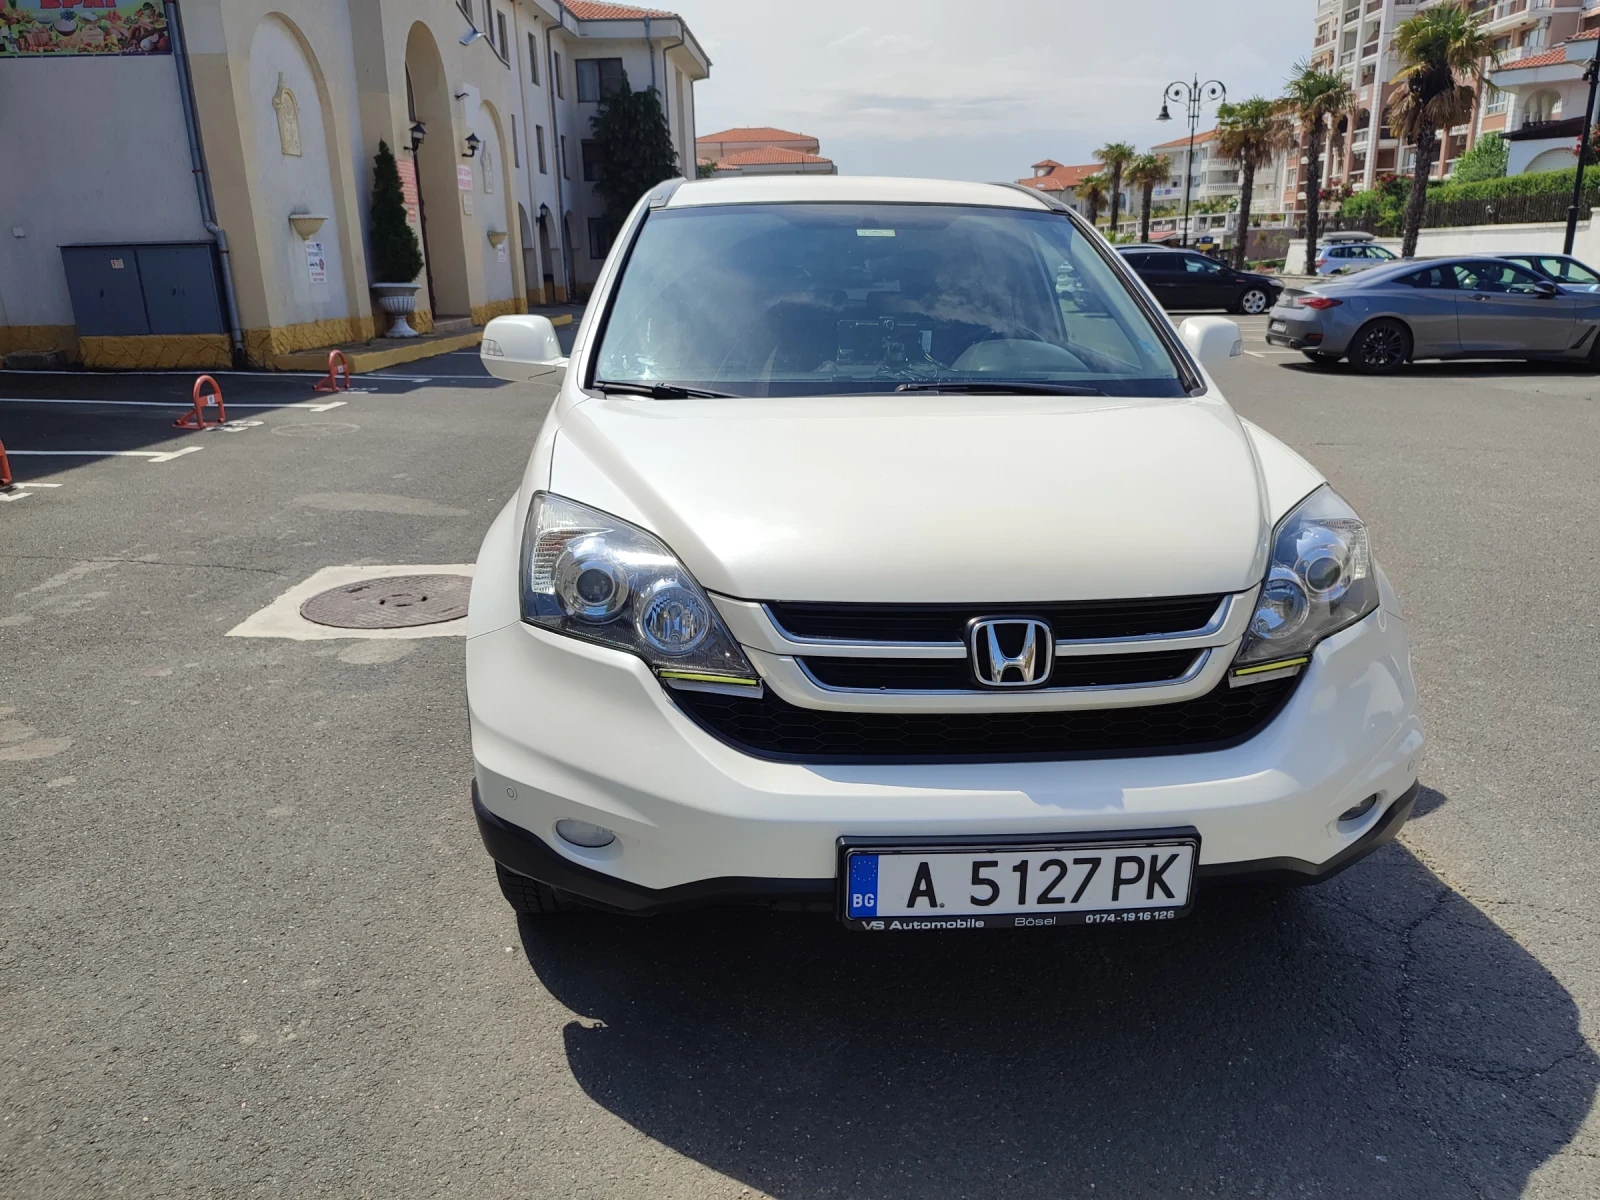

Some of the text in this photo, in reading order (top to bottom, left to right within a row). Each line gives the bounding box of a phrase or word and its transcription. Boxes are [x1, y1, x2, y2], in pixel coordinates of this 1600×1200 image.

[906, 853, 1180, 909] A 5127 PK
[852, 893, 875, 908] BG
[861, 920, 885, 931] VS
[889, 918, 985, 931] Automobile
[1014, 916, 1057, 927] Bösel
